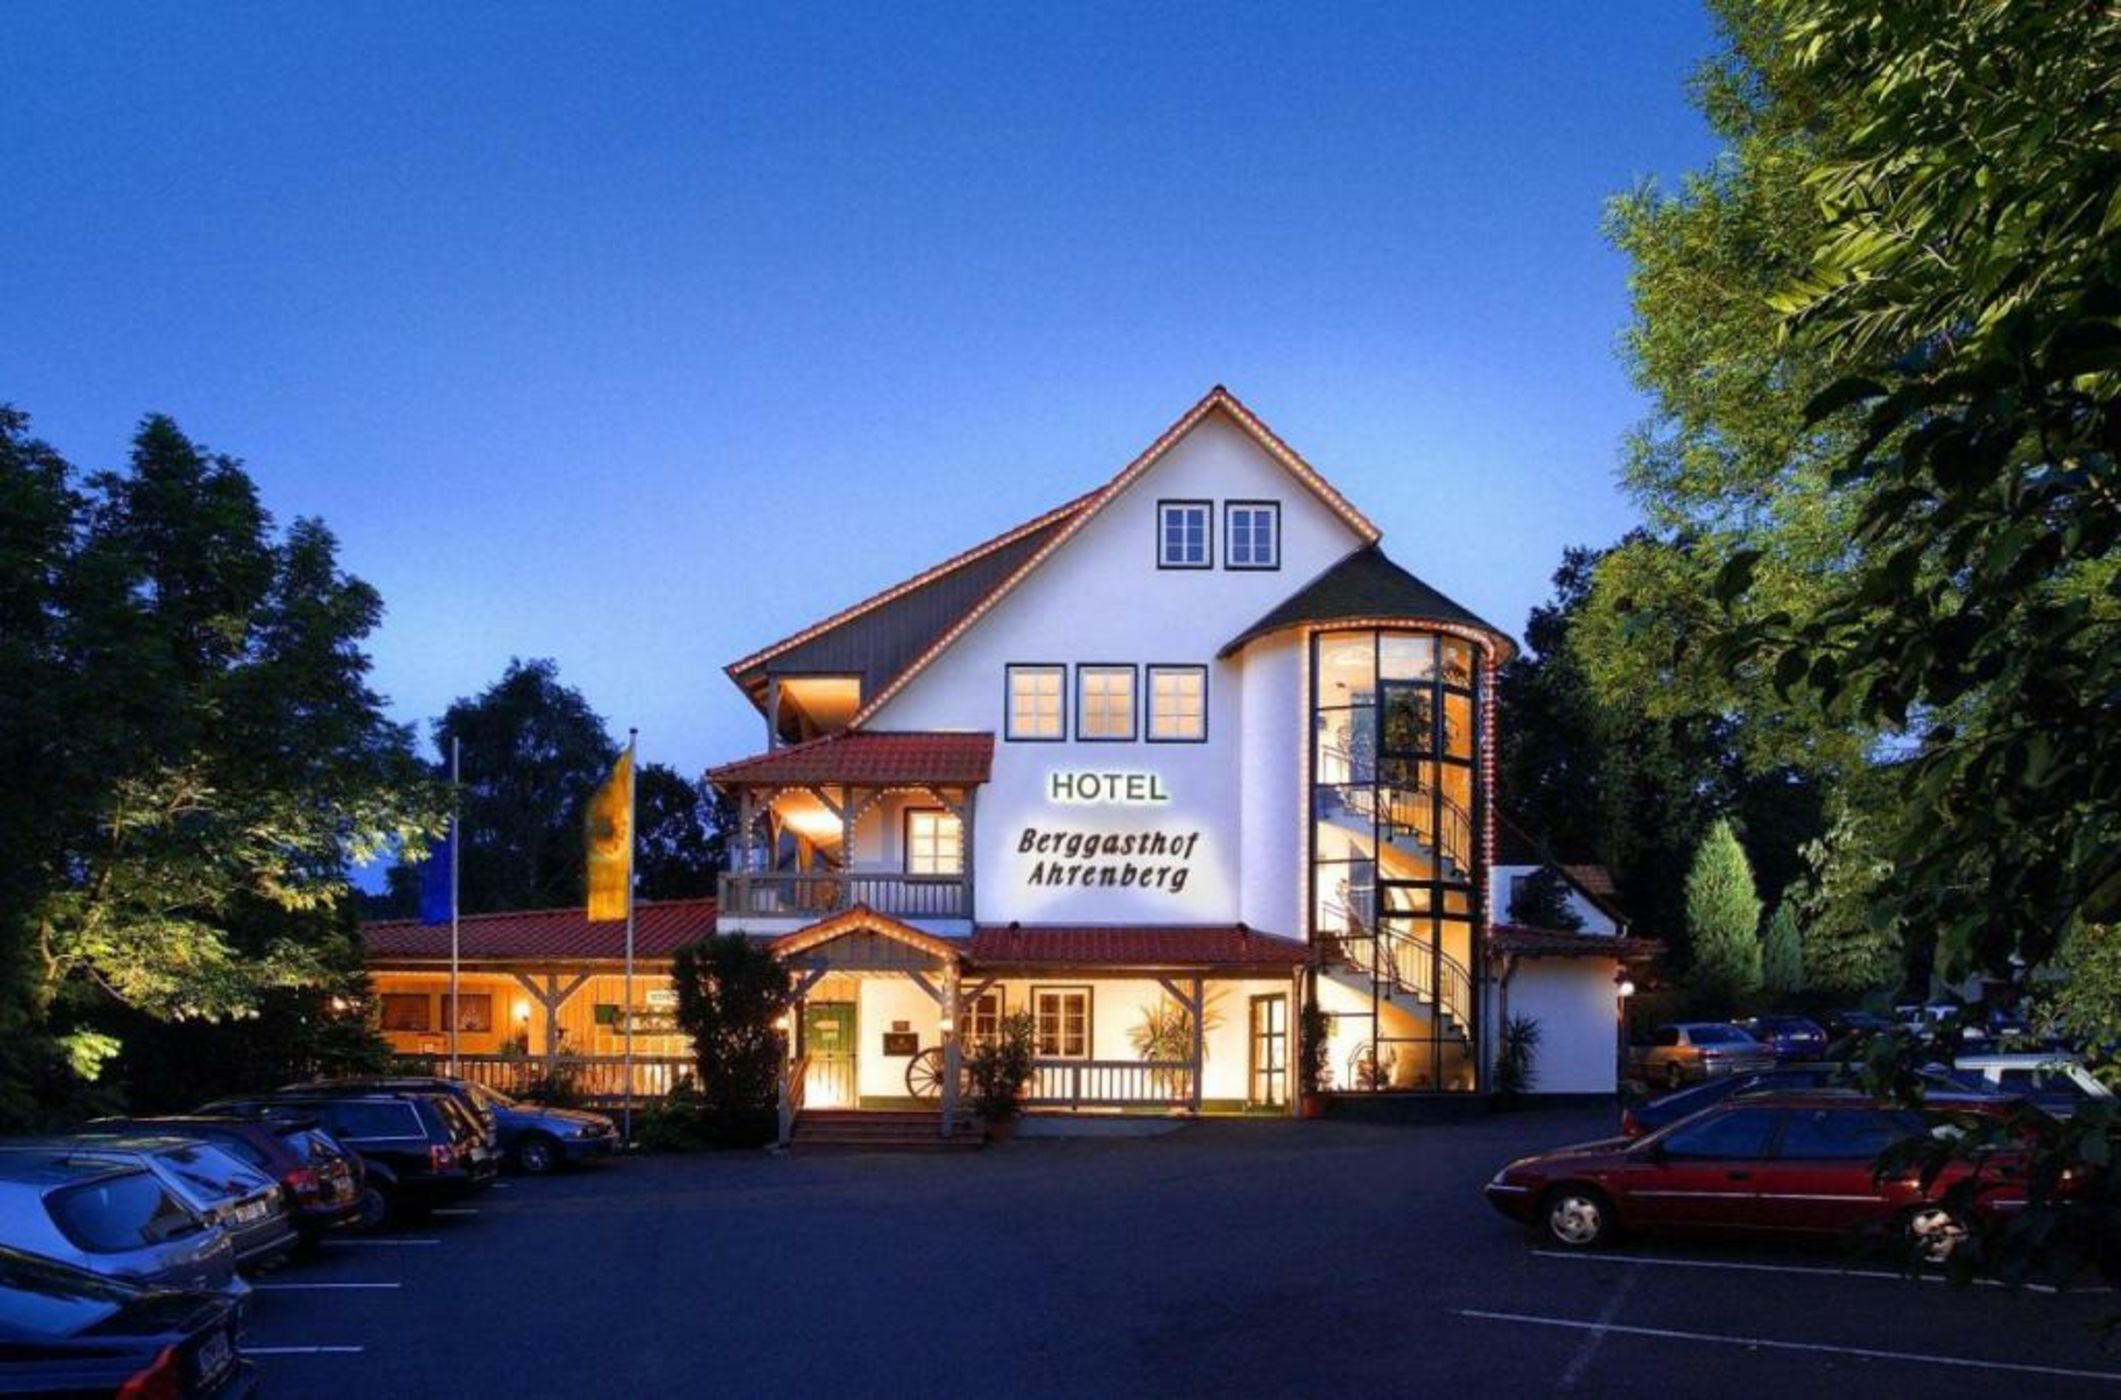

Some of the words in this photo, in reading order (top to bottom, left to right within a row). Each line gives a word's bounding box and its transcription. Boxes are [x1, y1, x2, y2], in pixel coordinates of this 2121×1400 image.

[1052, 773, 1168, 800] HOTEL
[1018, 828, 1199, 859] Berggasthof
[1028, 861, 1189, 893] Ahrenberg
